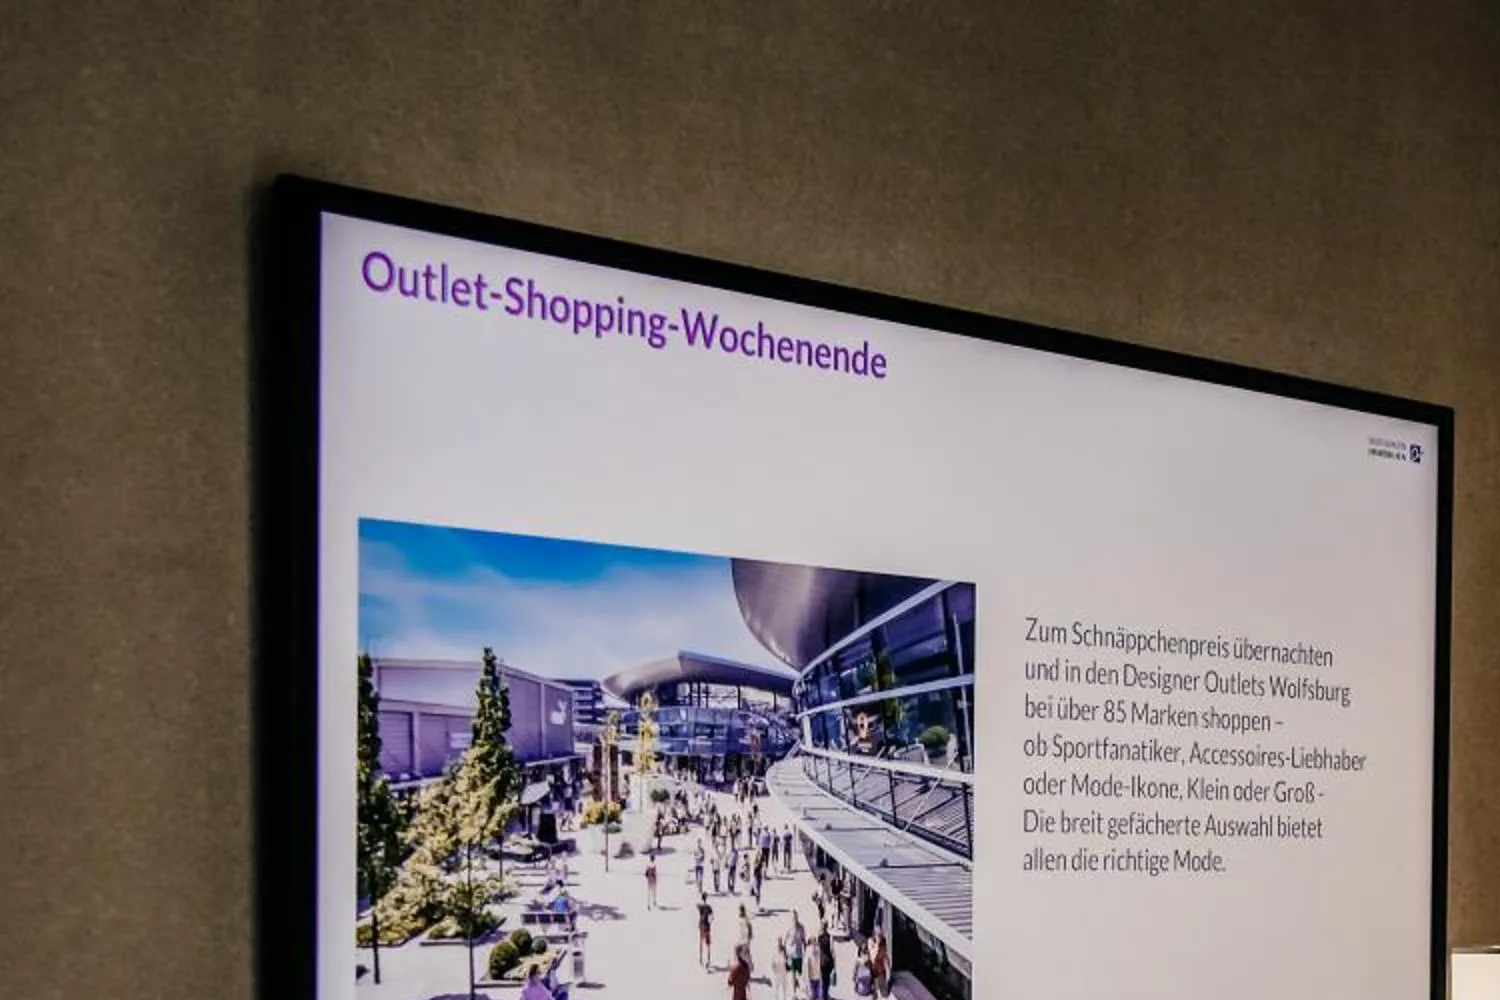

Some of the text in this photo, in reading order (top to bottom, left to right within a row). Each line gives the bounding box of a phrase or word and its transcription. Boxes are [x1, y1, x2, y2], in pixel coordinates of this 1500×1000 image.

[362, 250, 888, 379] Outlet-Shopping-Wochenende
[1026, 617, 1333, 667] Zum Schnäppchenpreis übernachten
[1026, 659, 1350, 707] und in den Designer Outlets Wolfsburg
[1025, 694, 1053, 719] bei
[1058, 697, 1100, 721] über
[1104, 700, 1126, 723] 85
[1132, 702, 1198, 727] Marken
[1202, 707, 1270, 734] shoppen
[1024, 734, 1366, 771] ob Sportfanatiker, Accessoires-Liebhaber
[1024, 773, 1067, 796] oder
[1072, 774, 1182, 800] Mode-Ikone,
[1187, 777, 1229, 800] Klein
[1234, 779, 1270, 802] oder
[1274, 782, 1315, 803] Groß
[1024, 810, 1322, 840] Die breit gefächerte Auswahl bietet
[1024, 848, 1225, 876] allen die richtige Mode.
